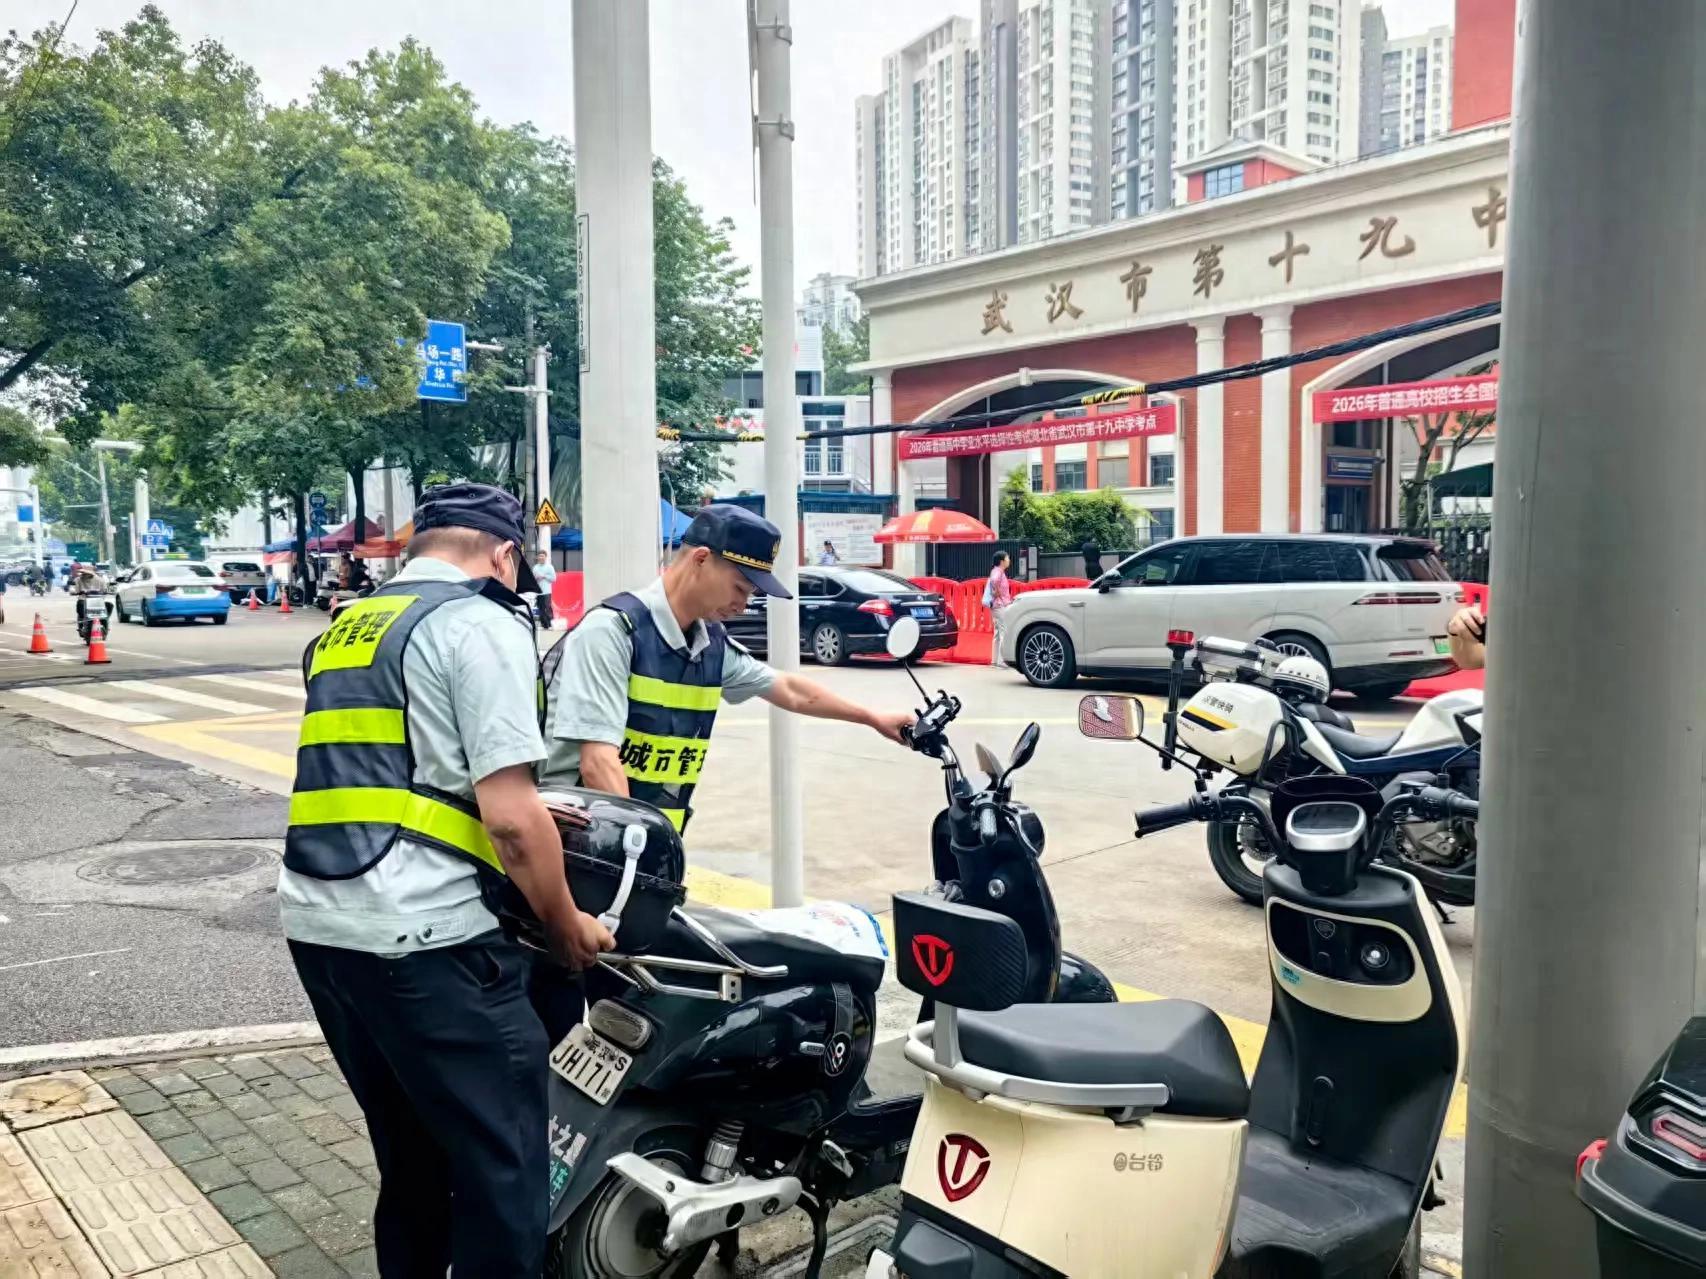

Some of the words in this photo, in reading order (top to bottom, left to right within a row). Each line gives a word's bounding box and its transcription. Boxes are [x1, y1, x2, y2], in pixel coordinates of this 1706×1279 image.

[981, 186, 1507, 336] 武汉市第十九中
[552, 1043, 611, 1095] JH171
